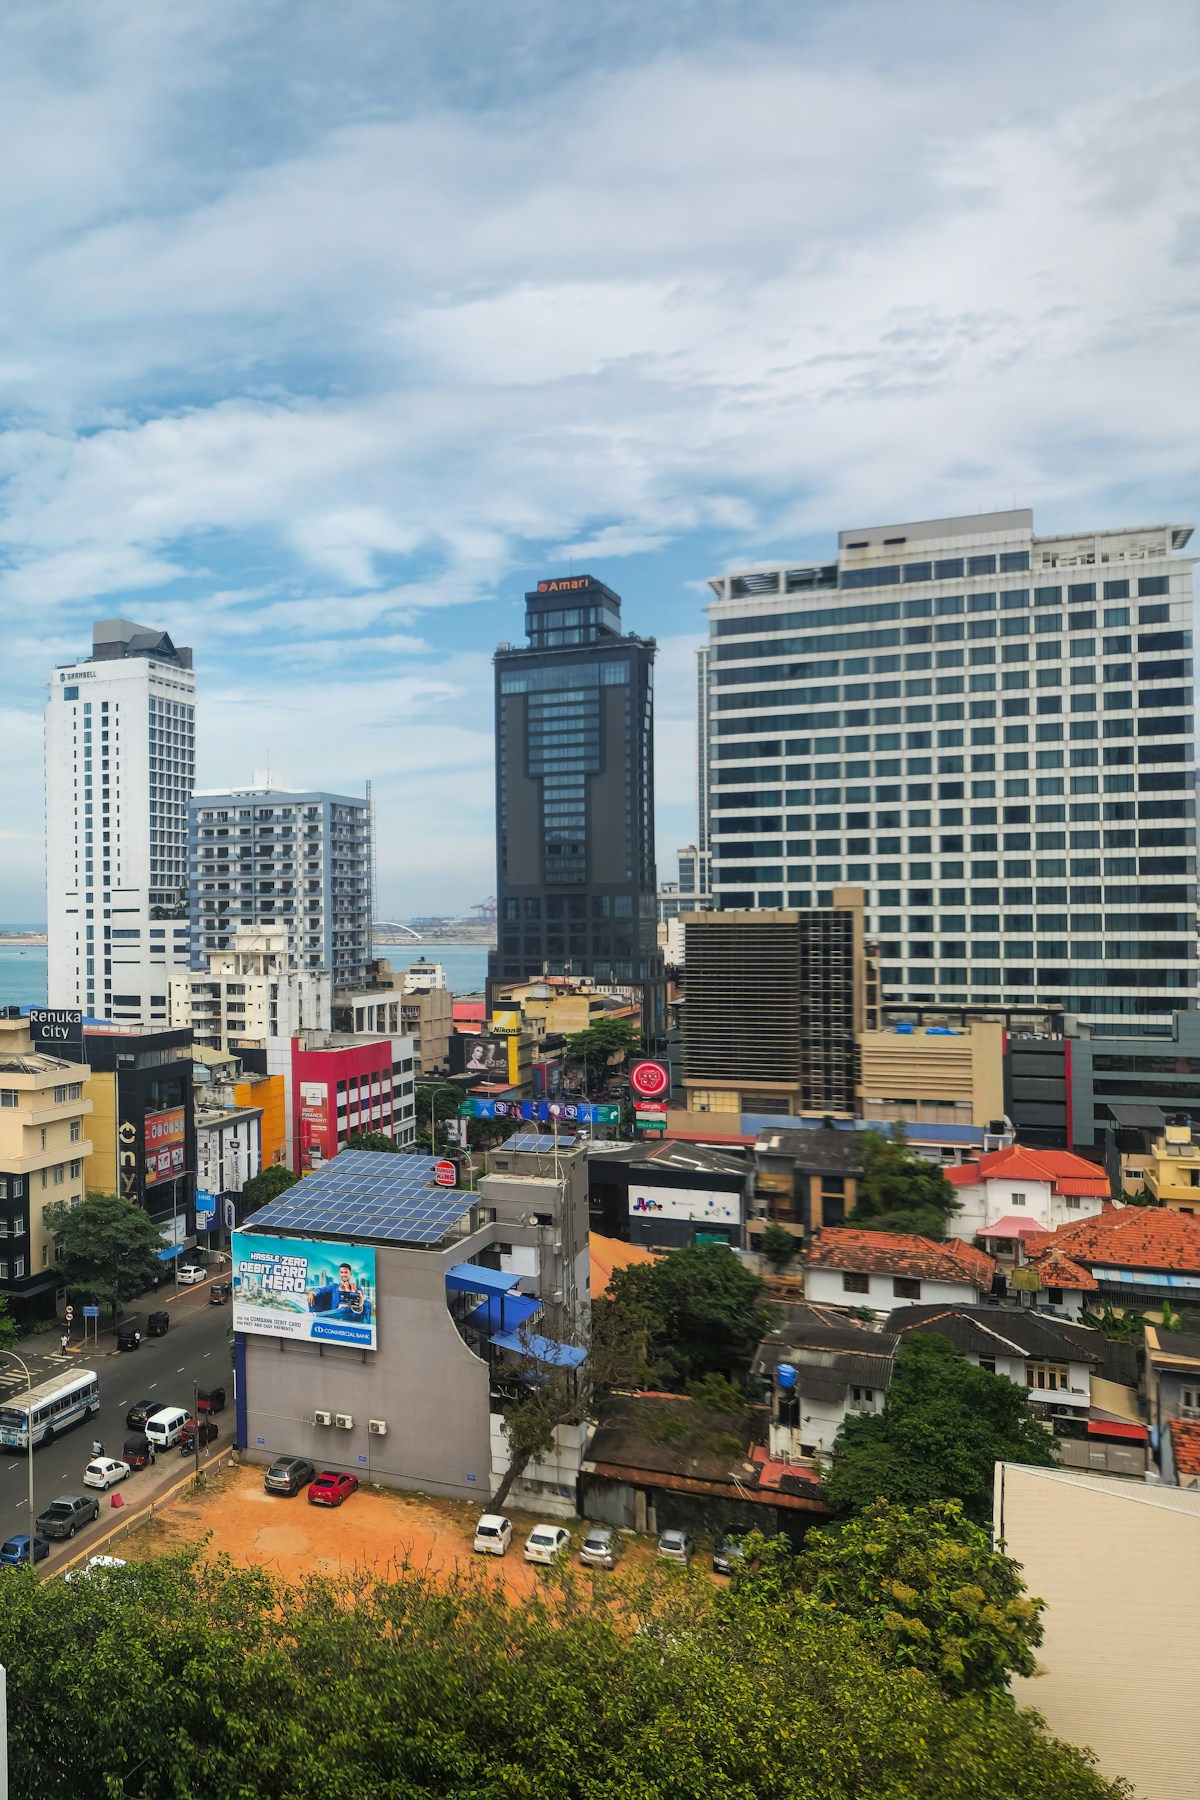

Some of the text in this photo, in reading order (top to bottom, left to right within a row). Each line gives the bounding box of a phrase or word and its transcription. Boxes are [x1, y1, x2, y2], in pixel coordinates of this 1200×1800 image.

[549, 579, 589, 592] Amari
[30, 1010, 81, 1023] Renuka
[41, 1024, 69, 1039] City
[435, 1167, 455, 1175] BURGER
[250, 1252, 308, 1268] HASSLE ZERO
[239, 1261, 307, 1279] DEBIT CARD
[261, 1274, 306, 1293] HERO
[250, 1316, 273, 1324] COMBANK
[324, 1328, 370, 1340] COMMERCIAL BANK
